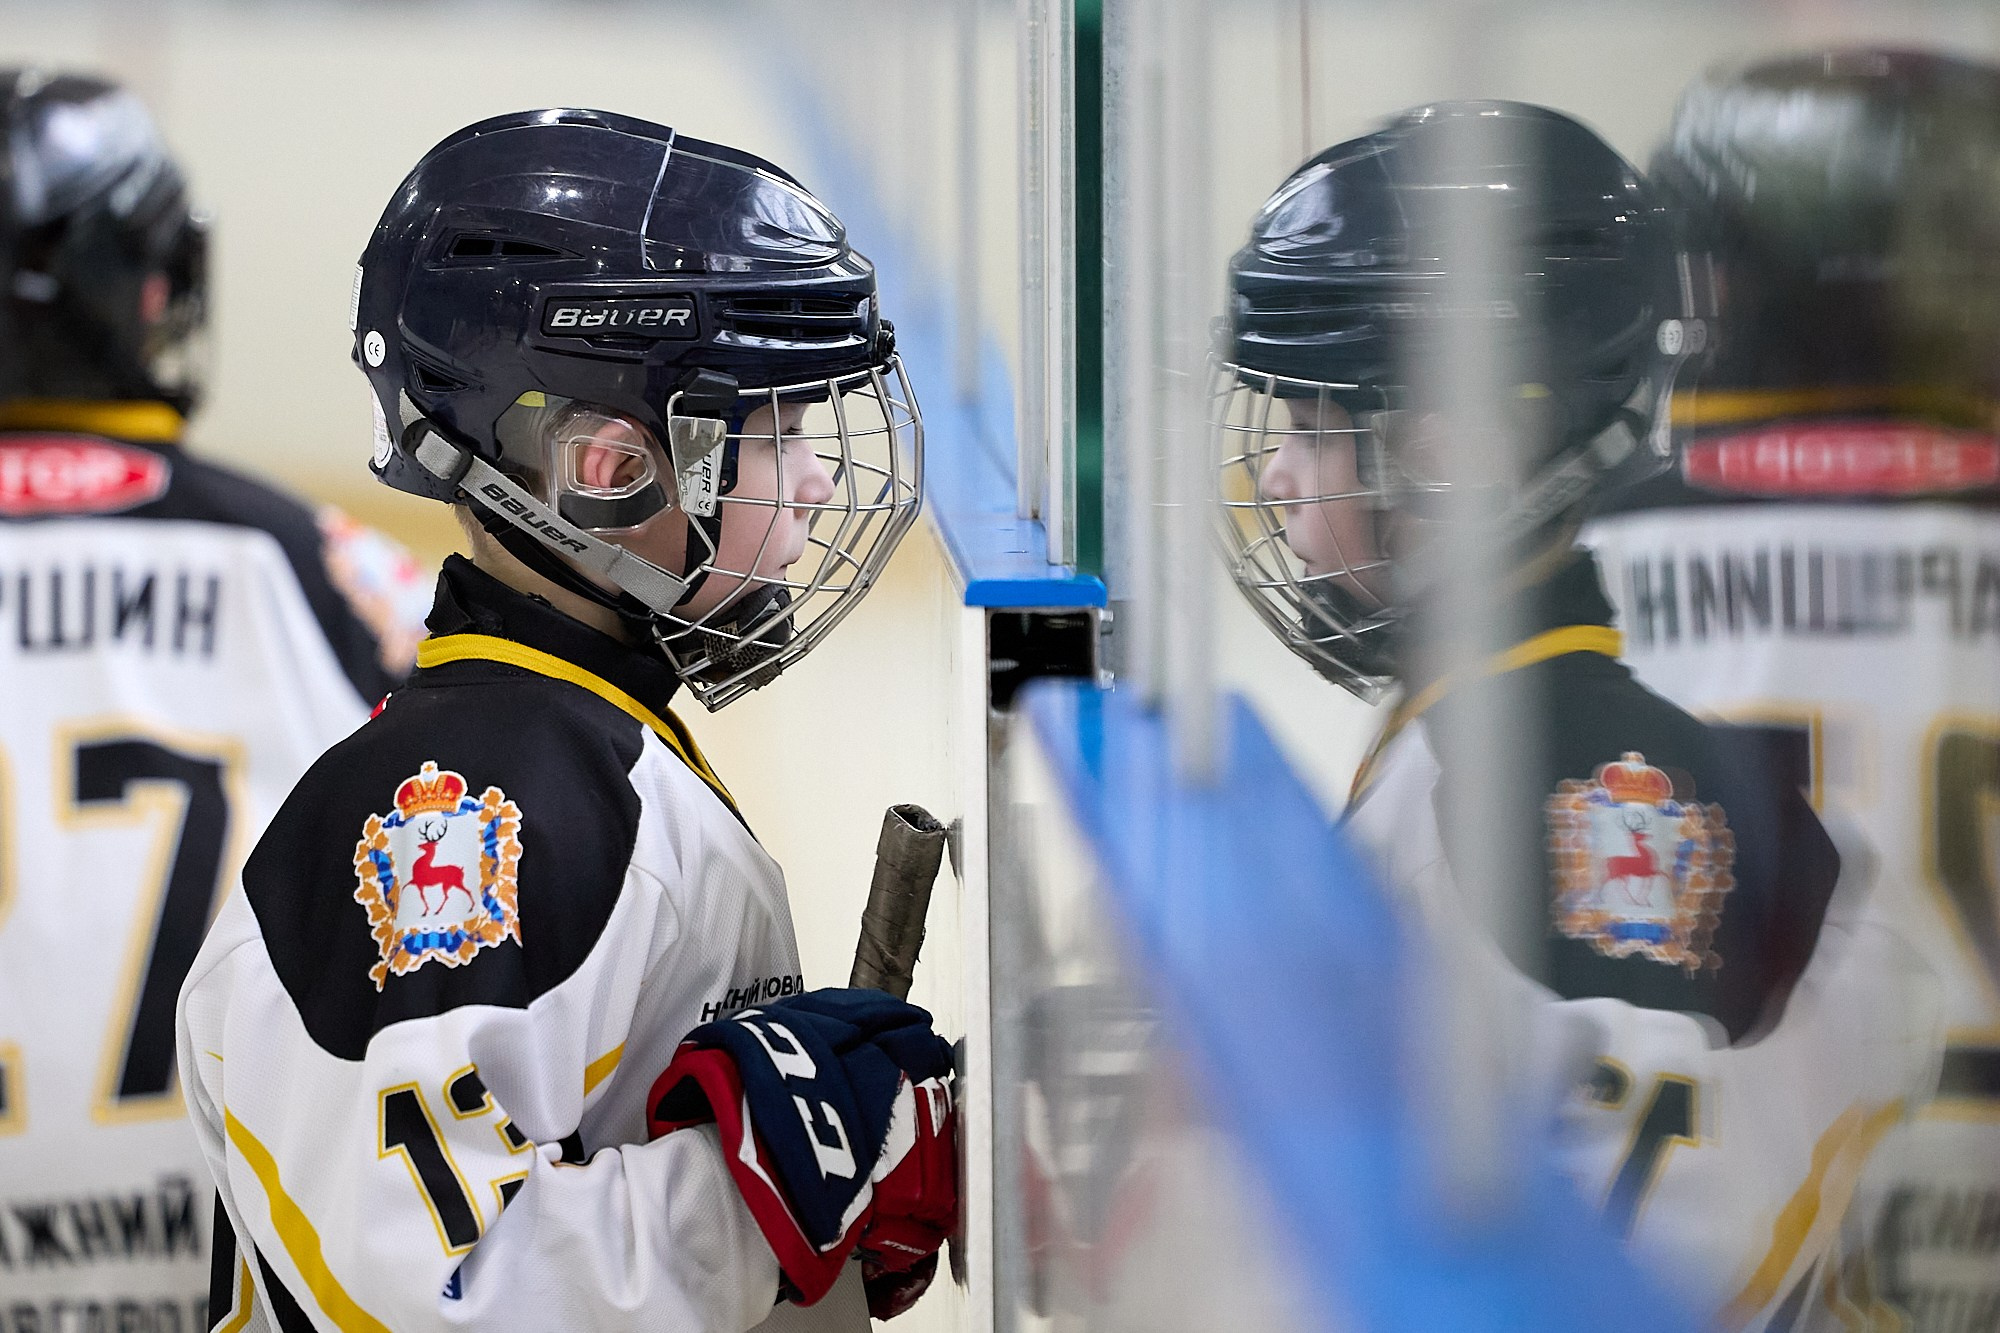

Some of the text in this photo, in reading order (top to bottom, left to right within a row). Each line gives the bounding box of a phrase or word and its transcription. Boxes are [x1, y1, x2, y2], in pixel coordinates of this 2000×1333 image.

[481, 483, 589, 554] BAUER
[0, 566, 220, 655] ШИН
[0, 717, 246, 1124] 7
[0, 1170, 201, 1268] ЖНИЙ
